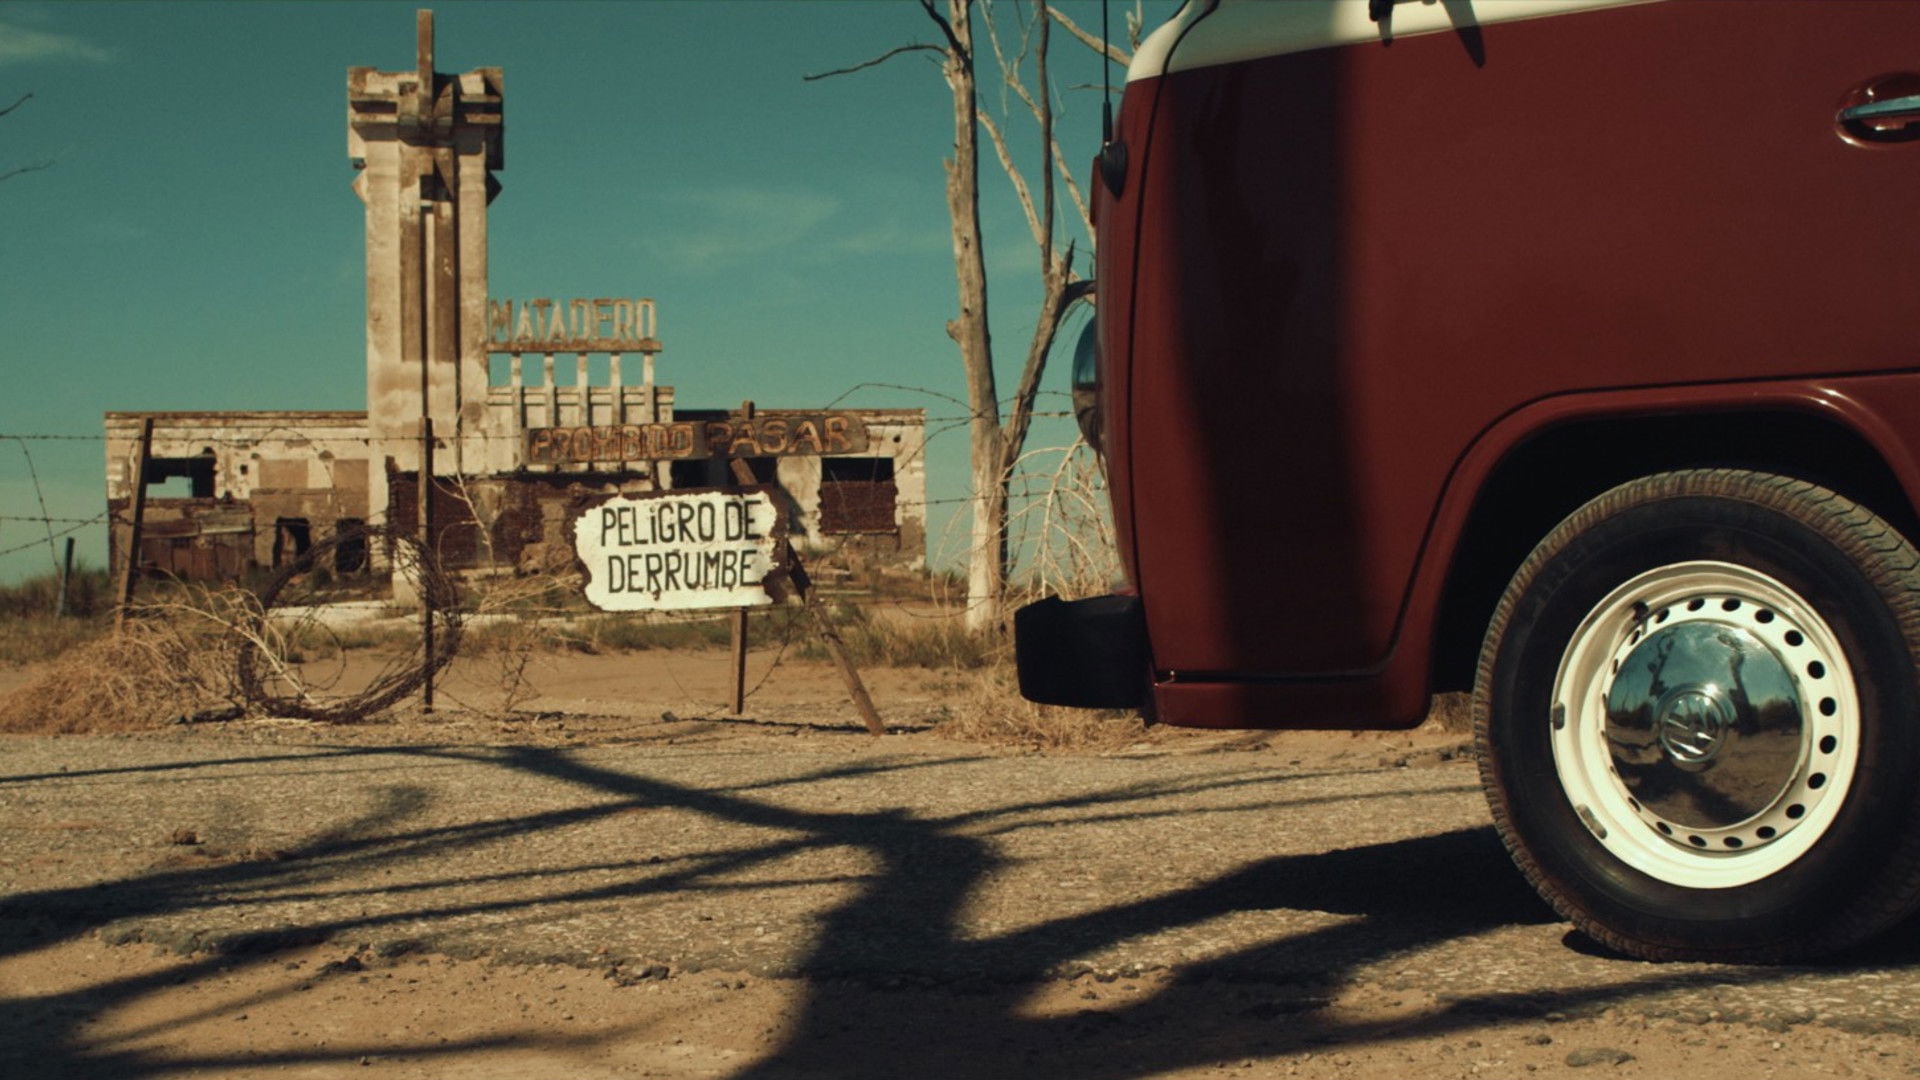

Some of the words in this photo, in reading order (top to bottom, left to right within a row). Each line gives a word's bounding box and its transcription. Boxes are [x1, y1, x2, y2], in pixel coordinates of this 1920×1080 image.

[490, 298, 656, 343] MATADERO
[708, 416, 853, 456] PASAR
[725, 500, 762, 541] DE
[608, 549, 762, 594] DERRUMBE
